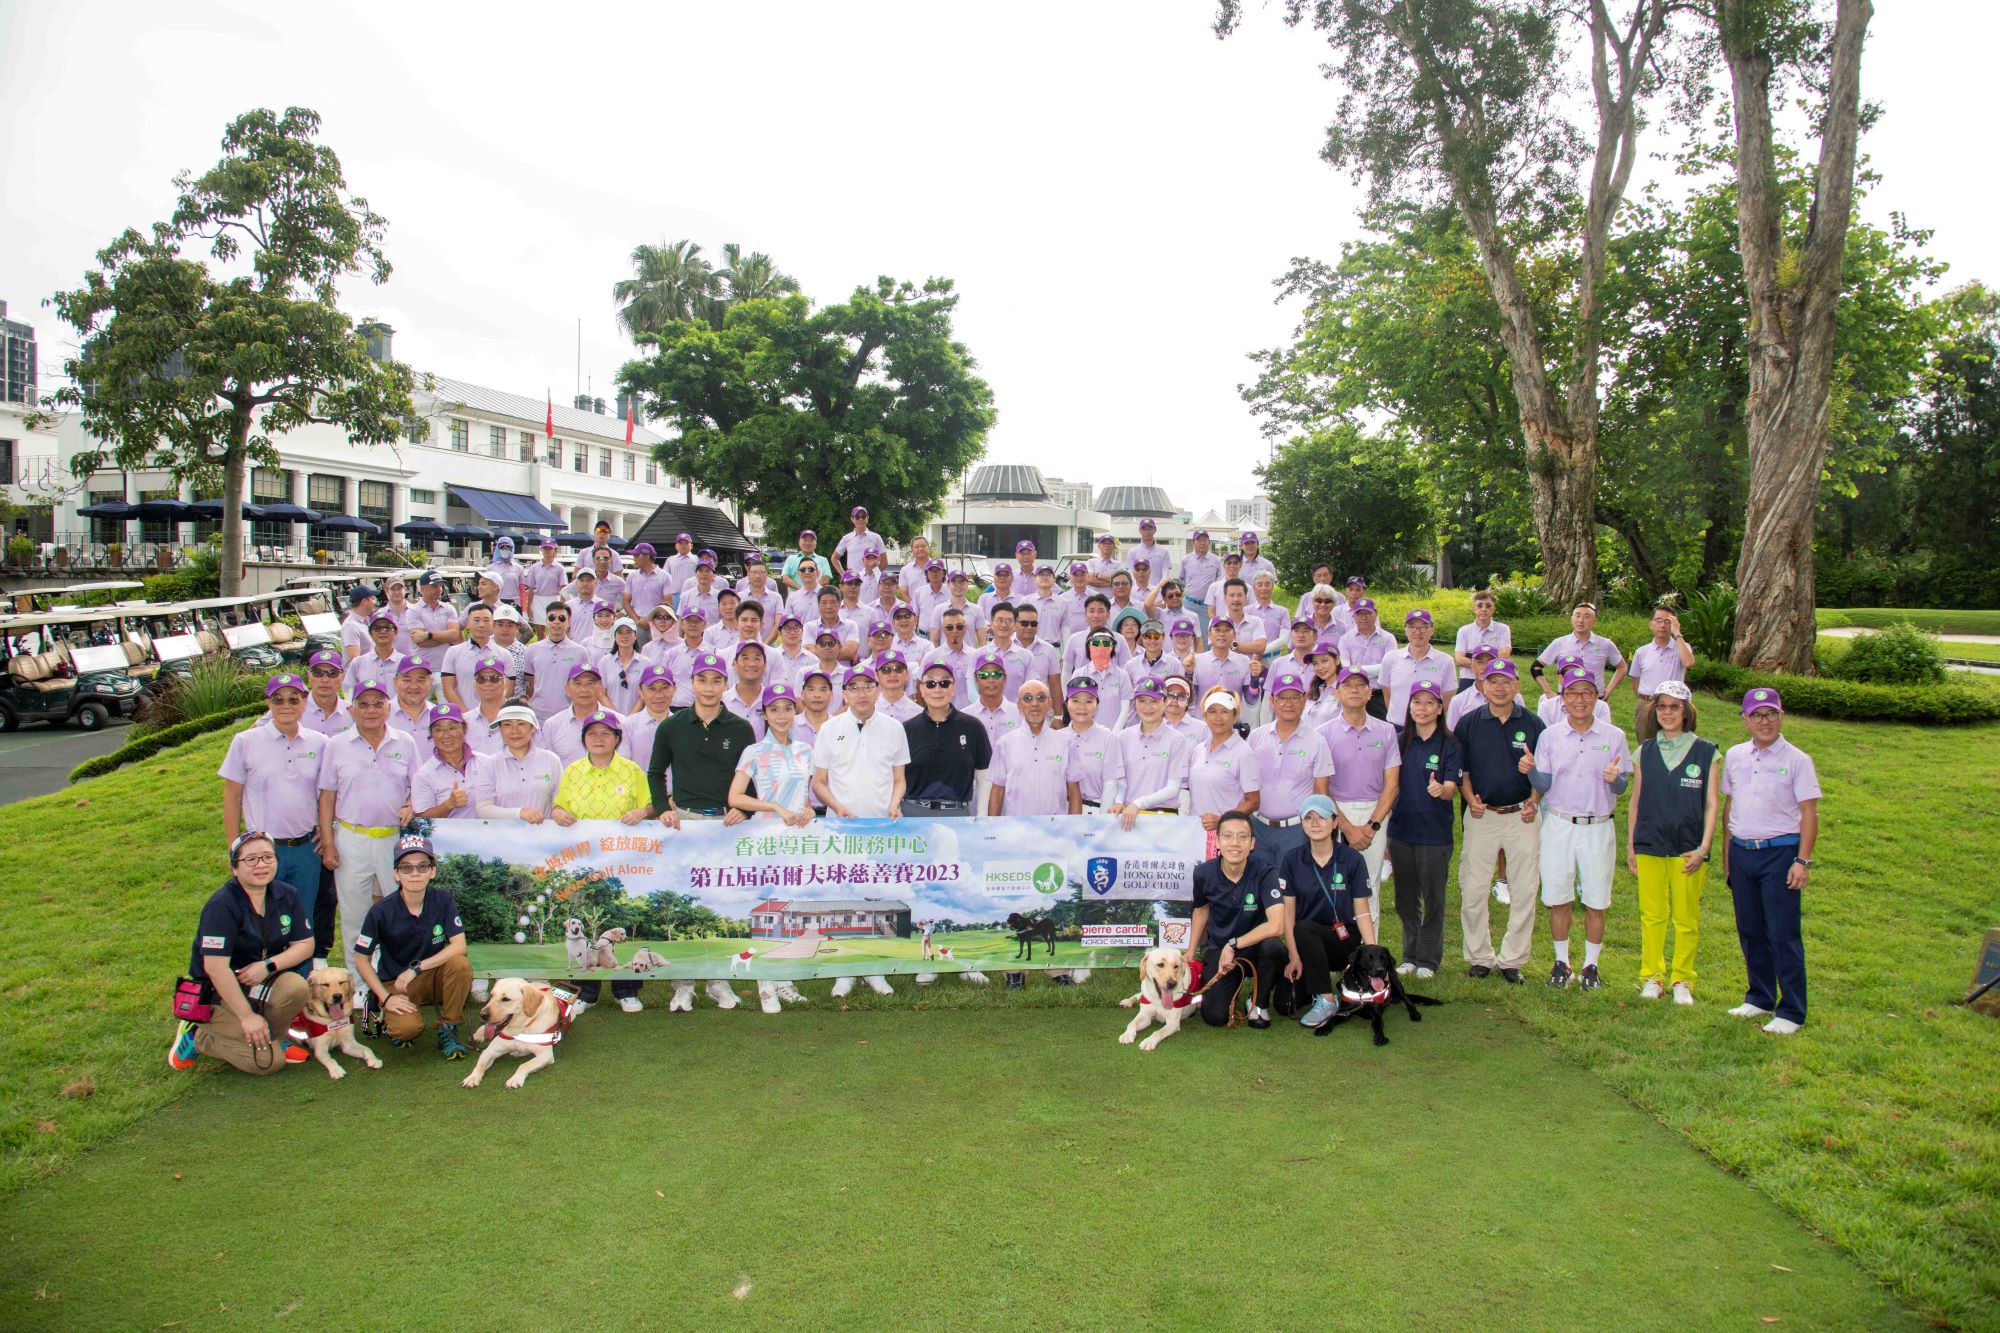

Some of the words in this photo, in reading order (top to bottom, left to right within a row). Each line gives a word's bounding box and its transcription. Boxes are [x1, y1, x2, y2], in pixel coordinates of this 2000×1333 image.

[734, 835, 928, 856] 香港導盲犬服務中心
[1124, 860, 1185, 870] 香港哥爾夫球會
[588, 865, 615, 882] Golf
[618, 863, 654, 875] Alone
[690, 863, 960, 888] 第五屆高爾夫球慈善賽2023
[985, 872, 1032, 882] HKSEDS
[1123, 871, 1154, 880] HONG
[1156, 871, 1185, 881] KONG
[1123, 881, 1151, 889] GOLF
[1152, 881, 1180, 890] CLUB
[1082, 926, 1112, 936] pierre
[1115, 924, 1148, 934] cardin
